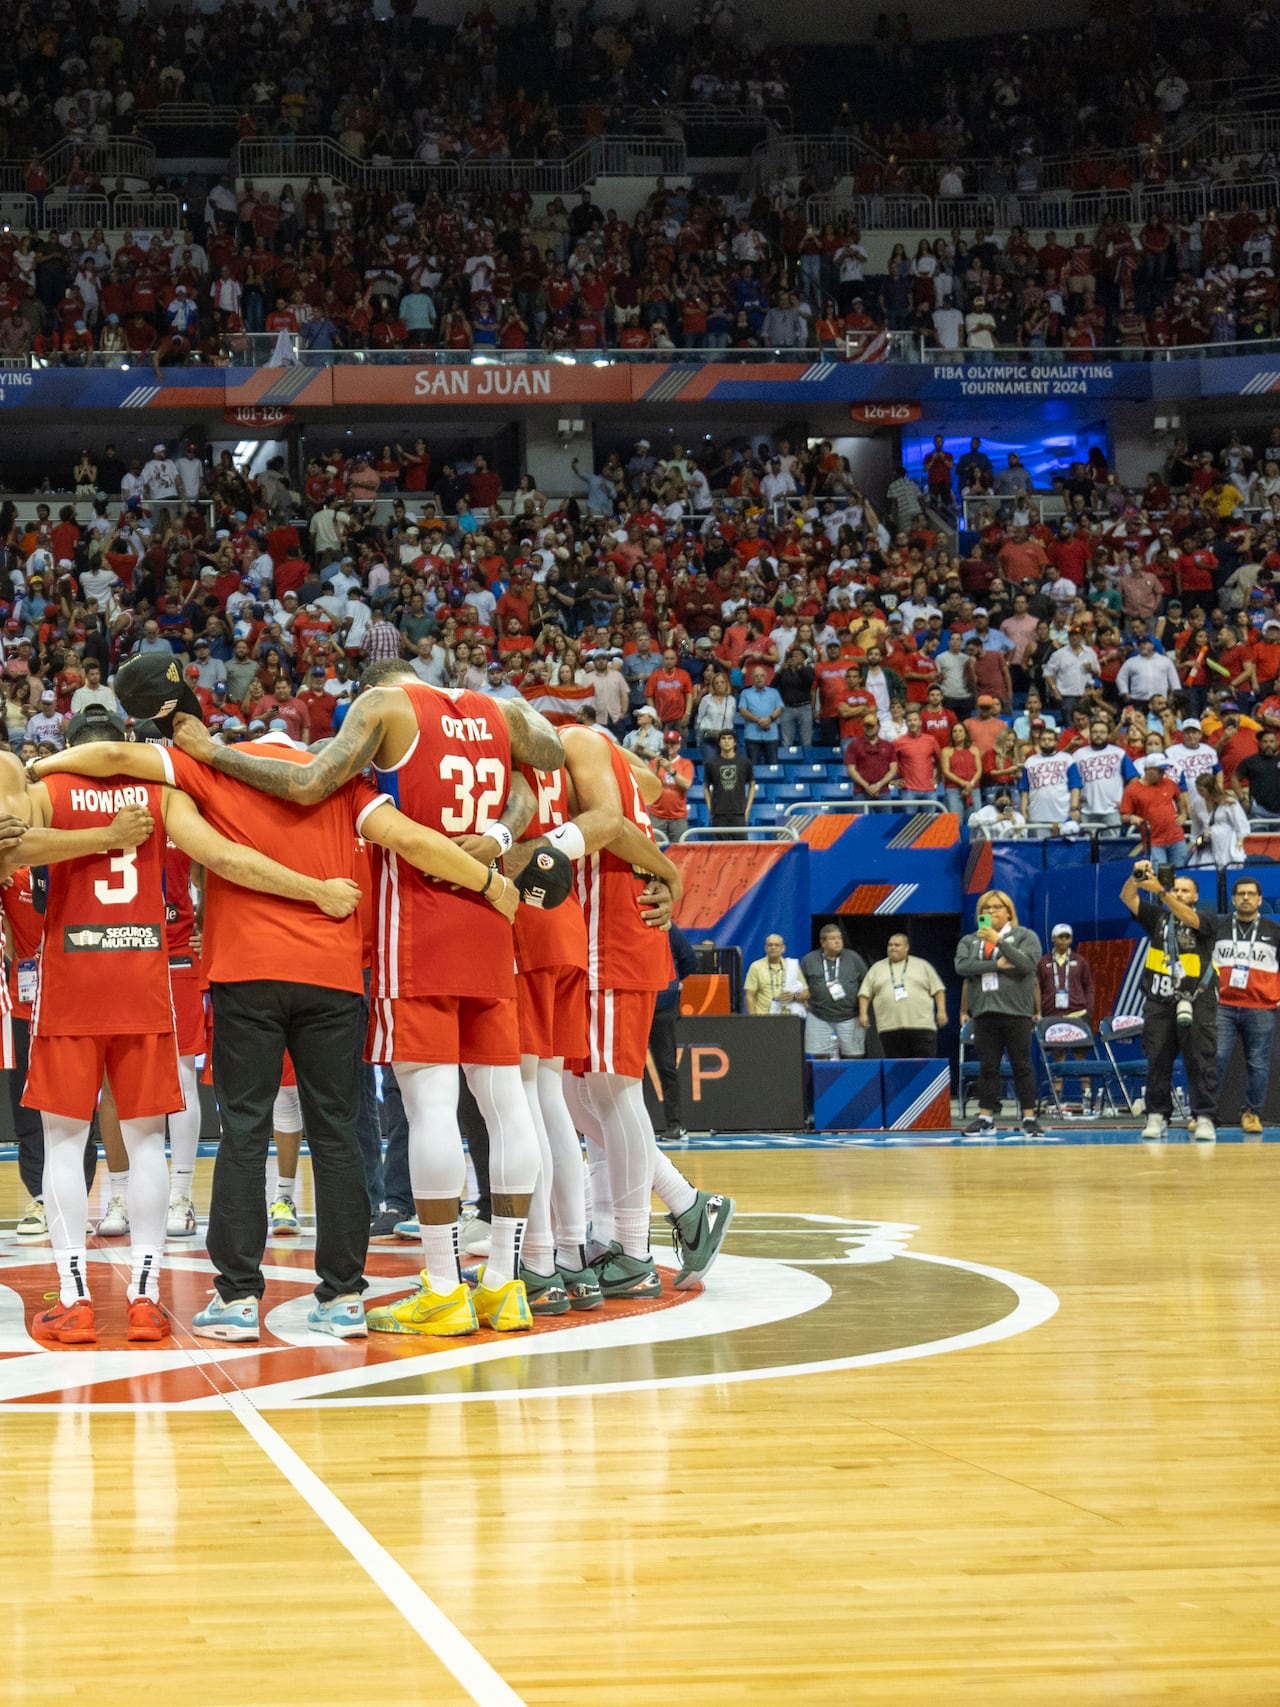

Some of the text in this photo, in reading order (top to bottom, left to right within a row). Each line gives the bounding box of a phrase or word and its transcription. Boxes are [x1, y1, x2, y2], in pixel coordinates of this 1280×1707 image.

[933, 366, 1113, 380] FIBA OLYMPIC QUALIFYING
[414, 369, 551, 396] SAN JUAN
[960, 380, 1088, 395] TOURNAMENT 2024
[236, 406, 283, 421] 101-126
[863, 405, 911, 419] 126-125
[441, 714, 493, 741] ORTIZ
[70, 786, 149, 814] HOWARD
[439, 754, 505, 833] 32
[94, 847, 139, 905] 3
[105, 926, 154, 938] SEGUROS
[101, 937, 159, 949] MULTIPLES
